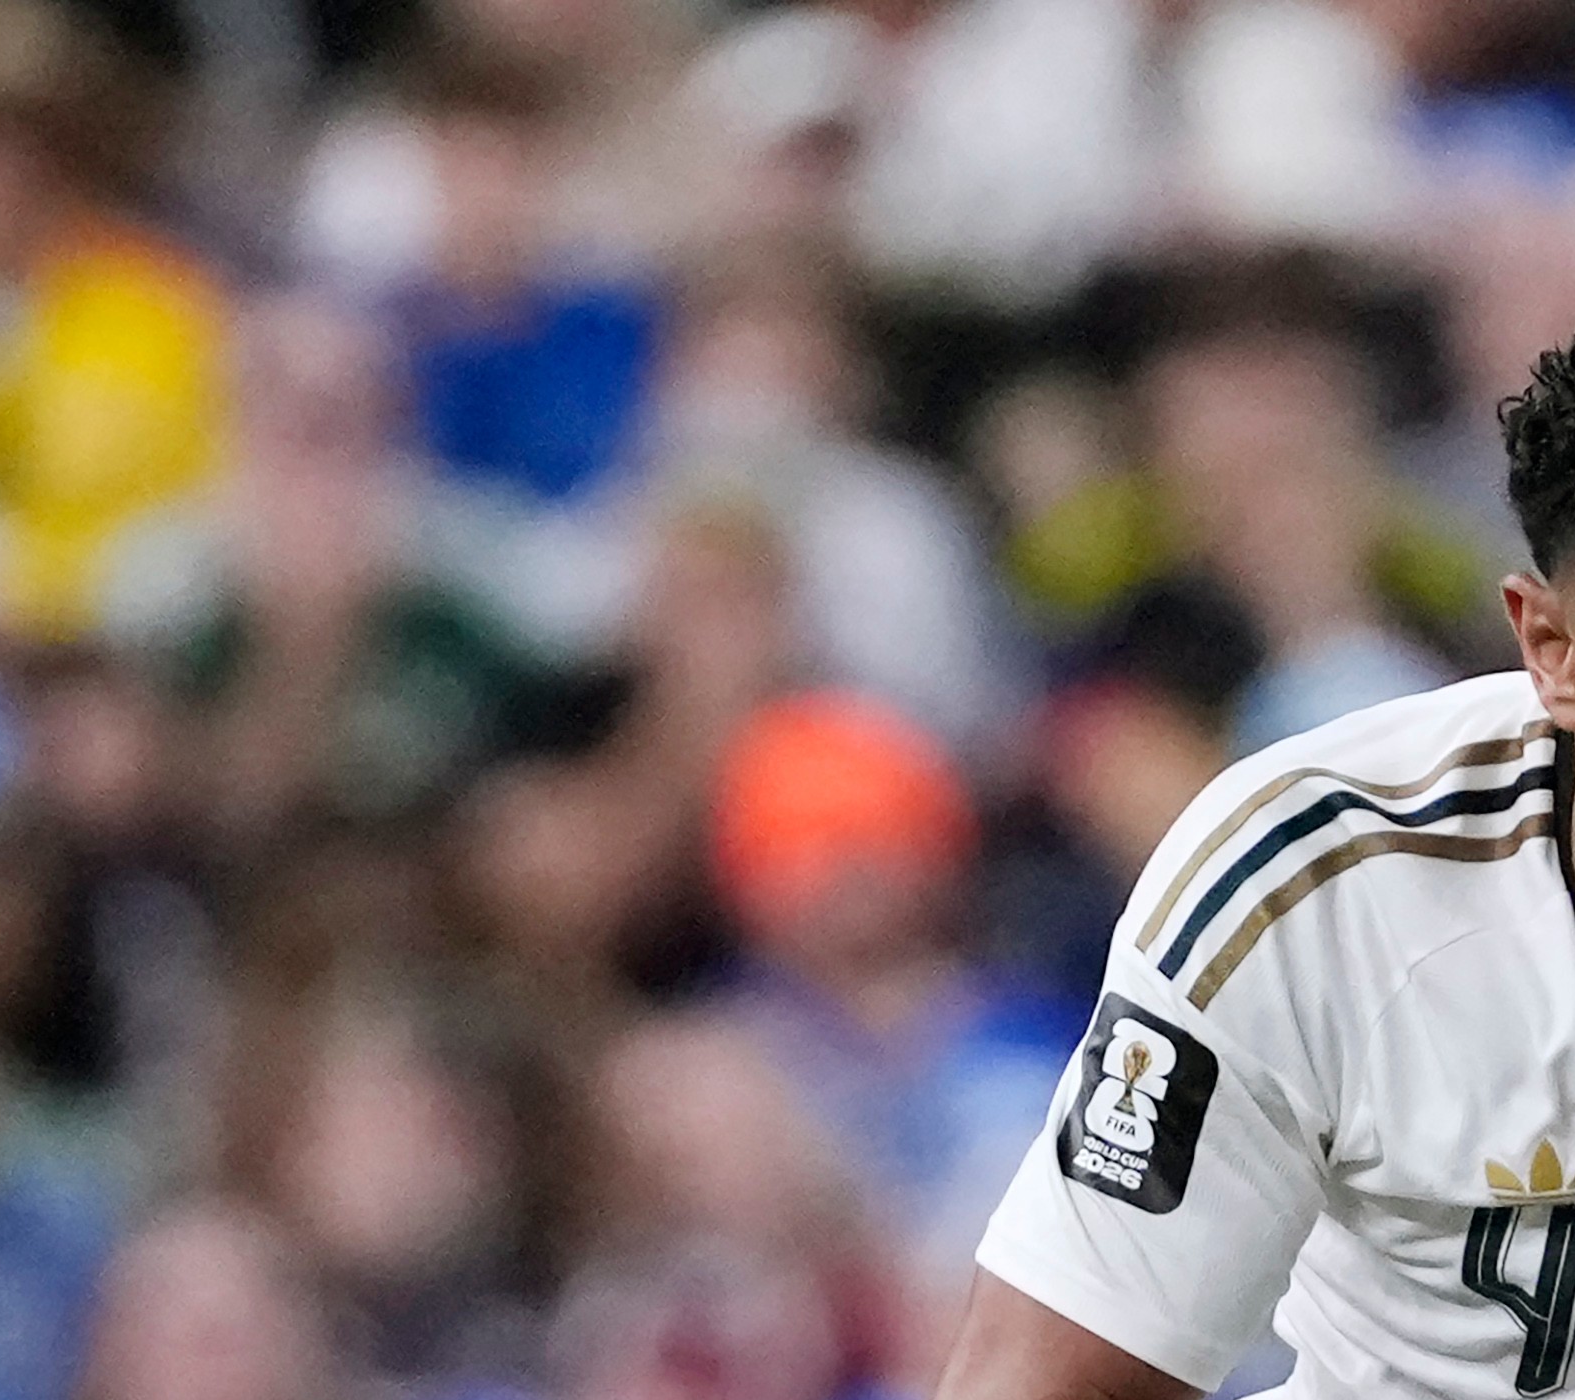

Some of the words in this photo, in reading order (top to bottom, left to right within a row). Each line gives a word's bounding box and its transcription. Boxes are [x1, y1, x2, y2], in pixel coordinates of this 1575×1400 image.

[1106, 1115, 1136, 1137] FIFA
[1073, 1148, 1143, 1190] 2026
[1084, 1135, 1121, 1161] ORLD
[1120, 1152, 1149, 1171] CUP
